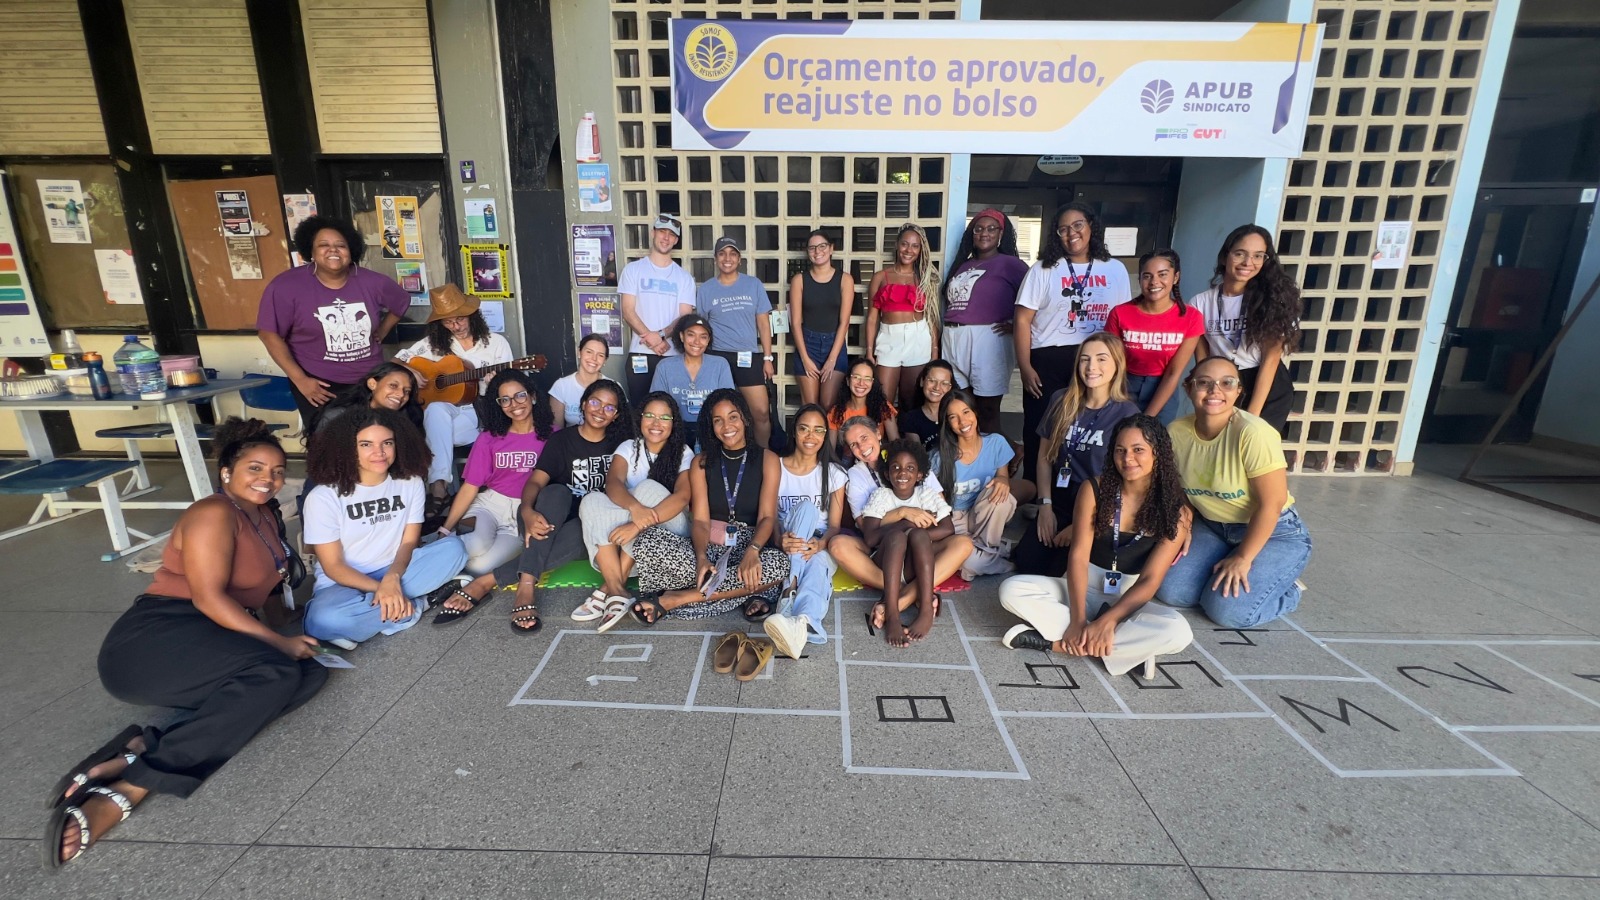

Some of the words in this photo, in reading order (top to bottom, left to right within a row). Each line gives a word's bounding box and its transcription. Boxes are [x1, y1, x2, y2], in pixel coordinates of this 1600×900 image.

[700, 27, 721, 36] SOMOS
[763, 52, 937, 88] Orçamento
[946, 54, 1105, 88] aprovado,
[1184, 81, 1254, 99] APUB
[903, 94, 942, 116] no
[952, 87, 1038, 117] bolso
[1183, 102, 1251, 113] SINDICATO
[1193, 128, 1222, 139] CUT
[640, 277, 679, 292] UFBA
[584, 301, 615, 310] PROSEL
[720, 295, 752, 303] COLUMBIA
[1122, 330, 1184, 345] MEDICINA
[346, 341, 367, 350] UFBA
[495, 451, 538, 468] UFB
[1214, 488, 1246, 499] CRIA
[346, 495, 406, 520] UFBA
